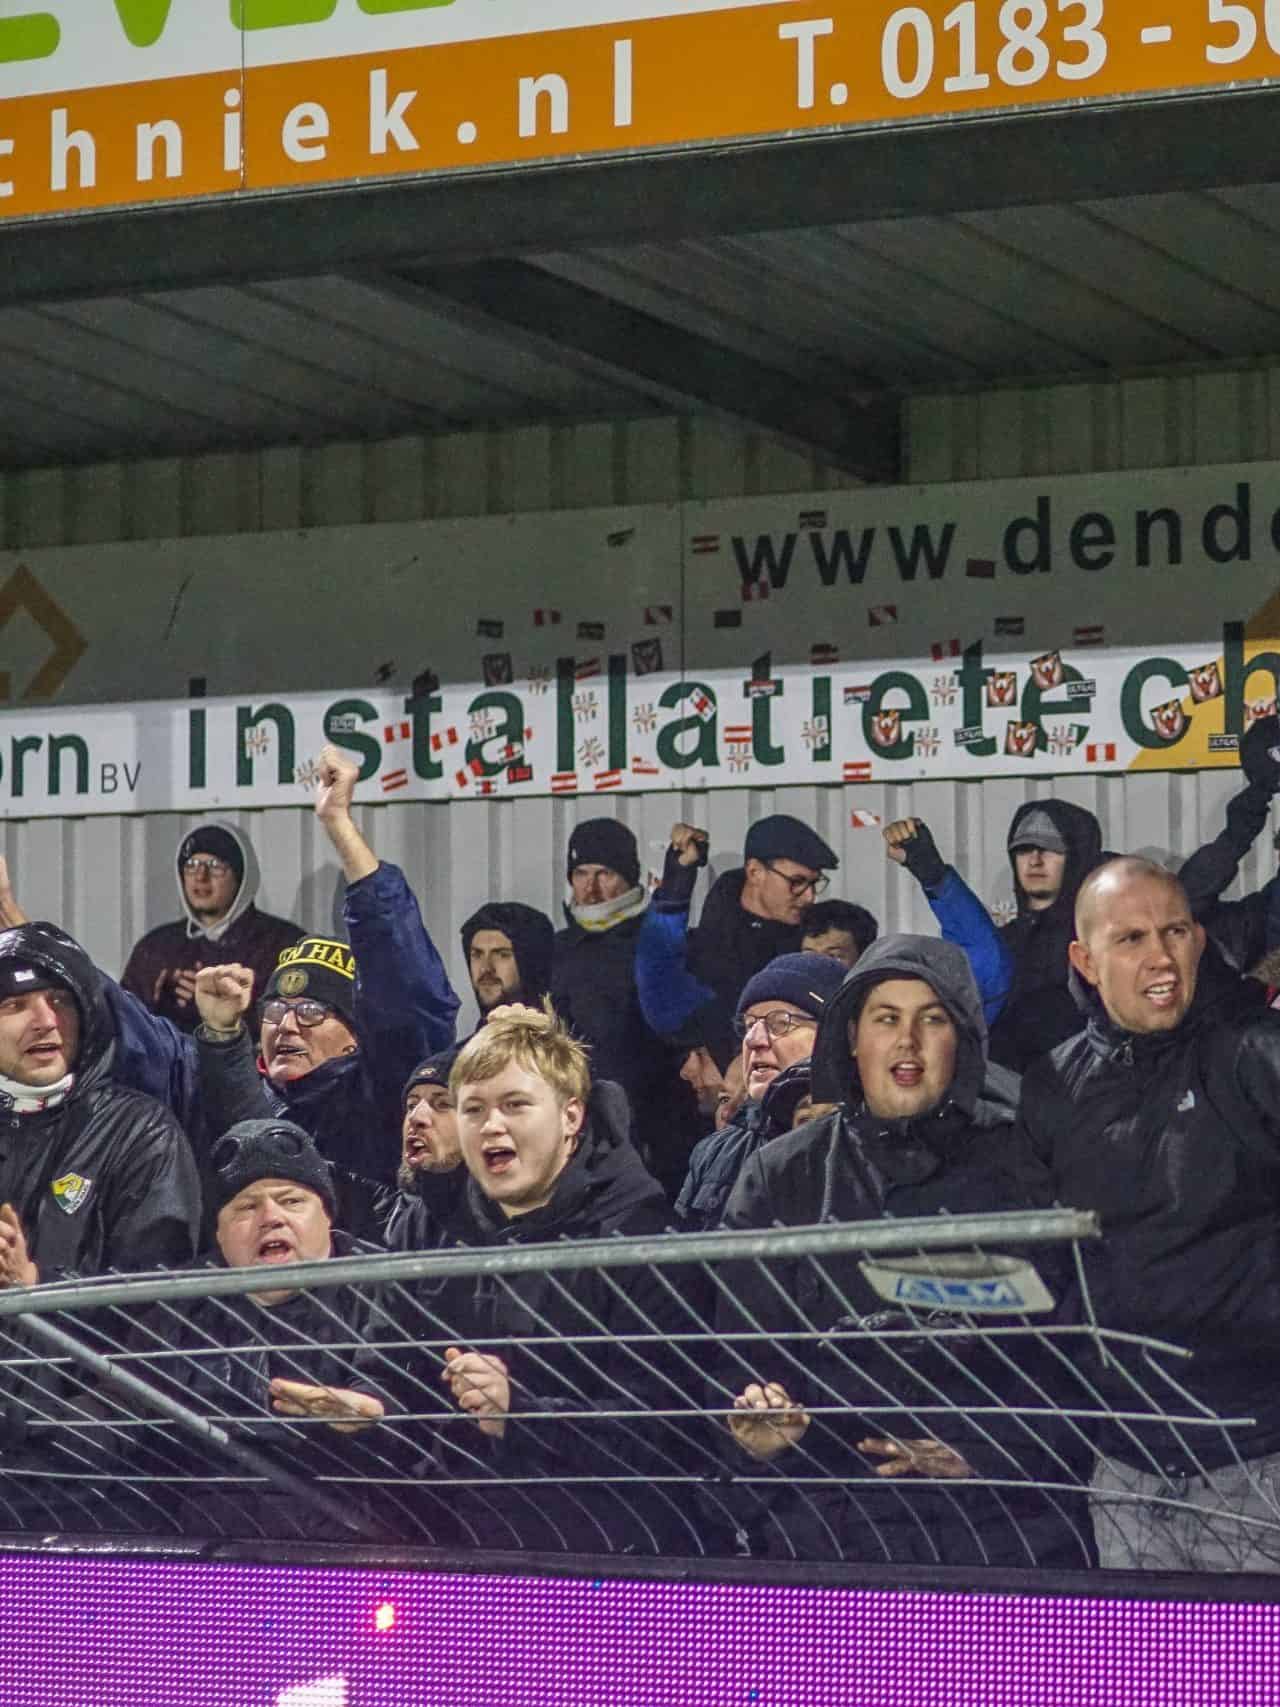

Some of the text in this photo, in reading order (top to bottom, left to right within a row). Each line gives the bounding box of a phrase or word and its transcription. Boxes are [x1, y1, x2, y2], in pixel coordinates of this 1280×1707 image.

[778, 17, 849, 109] T.
[880, 0, 1108, 99] 0183
[0, 732, 90, 798] rn
[100, 762, 142, 794] BV
